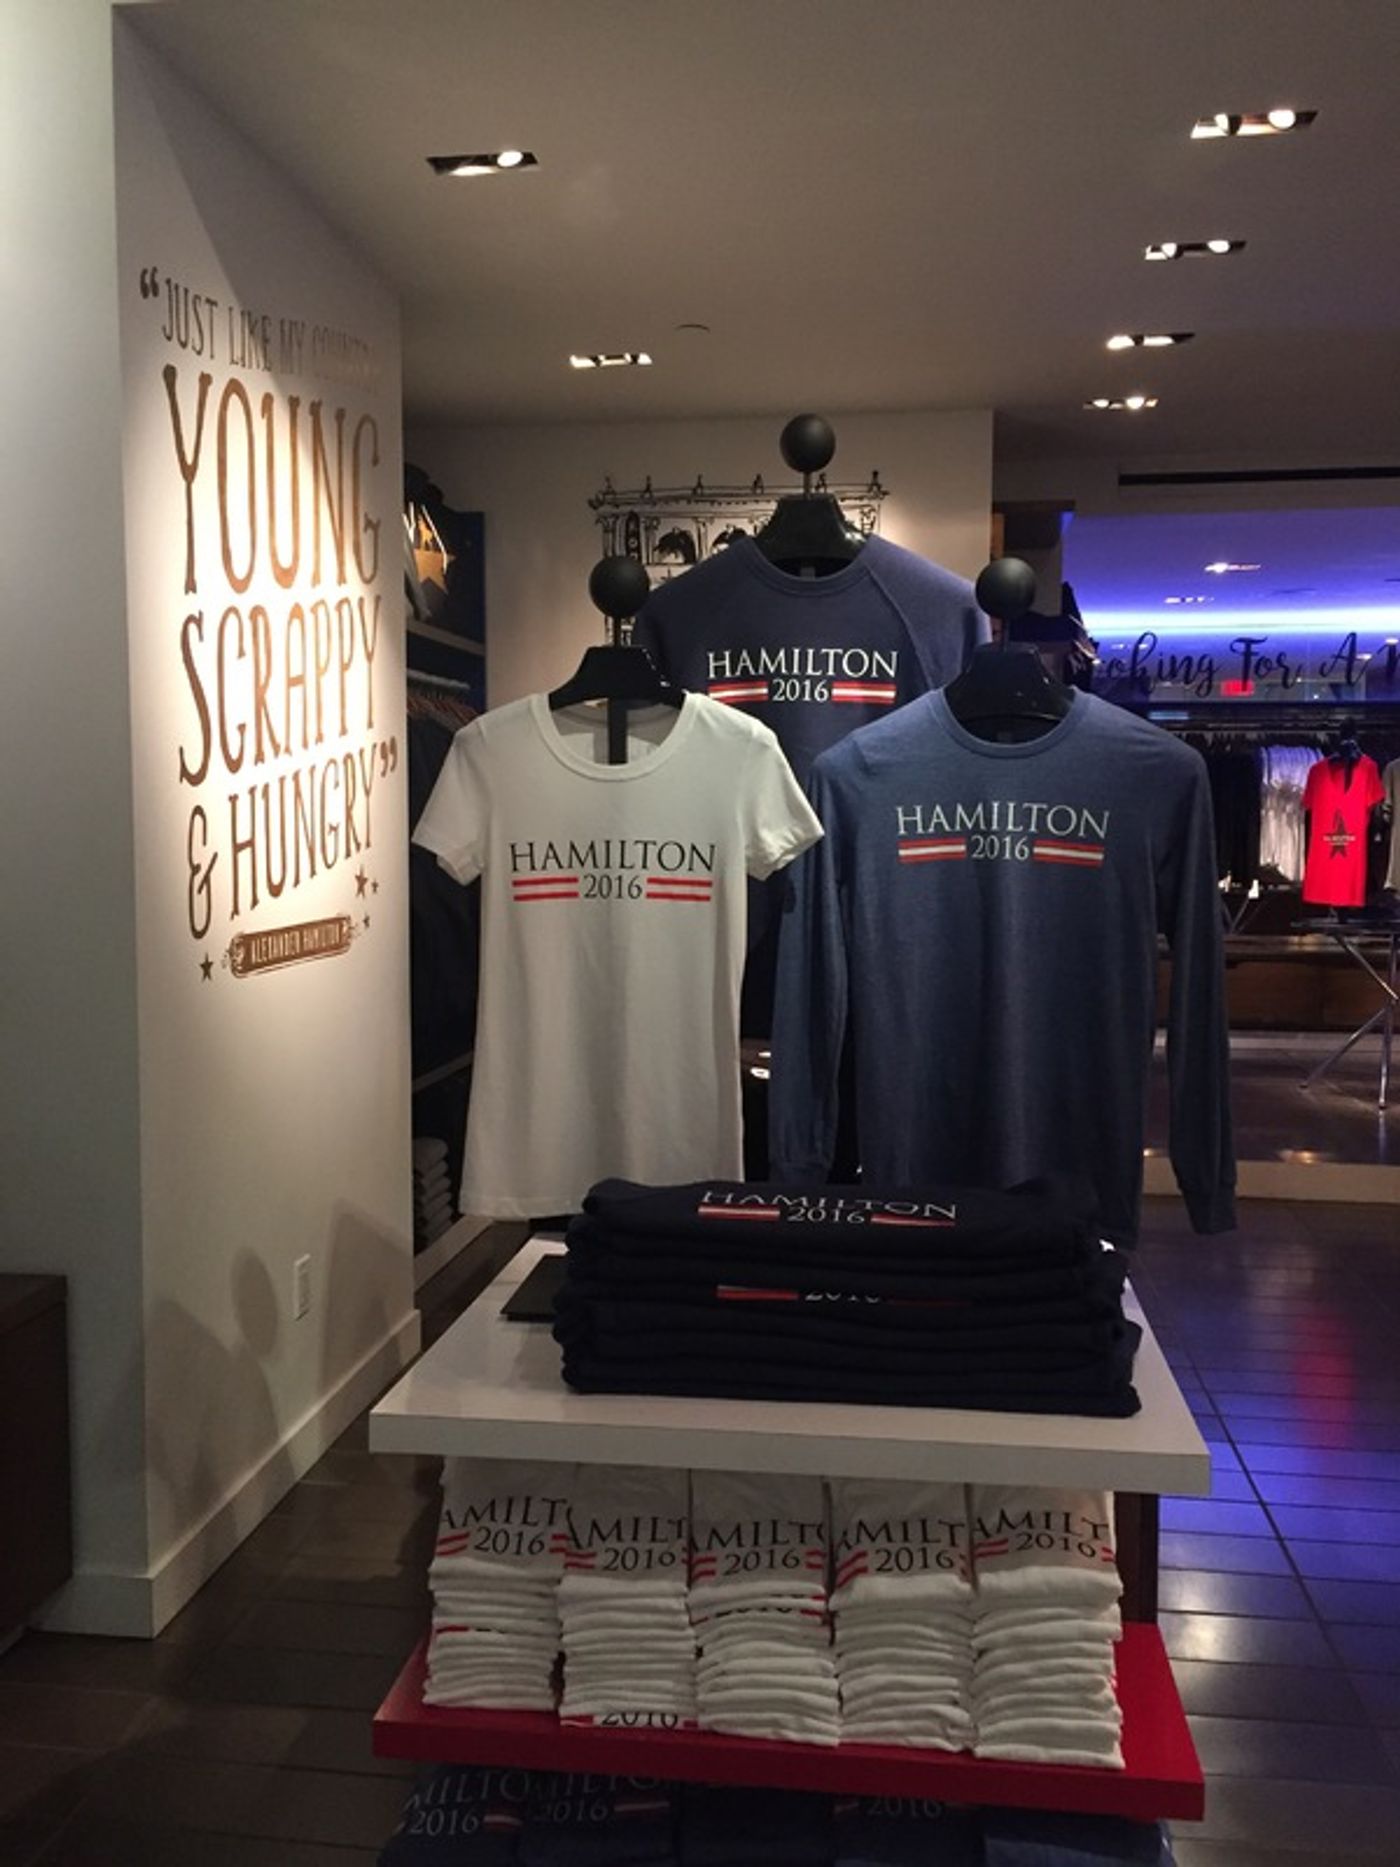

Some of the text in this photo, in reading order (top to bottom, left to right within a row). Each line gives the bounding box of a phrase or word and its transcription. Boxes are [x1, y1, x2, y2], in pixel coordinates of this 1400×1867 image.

[228, 305, 272, 372] LIKE
[280, 317, 305, 375] MY
[162, 363, 381, 595] YOUNG
[708, 648, 898, 678] HAMILTON
[1229, 636, 1302, 694] For
[1319, 632, 1370, 687] A
[179, 594, 381, 787] SCRAPPY
[772, 678, 830, 702] 2016
[897, 801, 1110, 839] HAMILTON
[510, 840, 716, 873] HAMILTON
[971, 835, 1029, 861] 2016
[188, 805, 218, 939] &
[583, 874, 643, 900] 2016
[788, 1206, 865, 1223] 2016
[474, 1526, 545, 1555] 2016
[723, 1549, 800, 1576] 2016
[875, 1546, 954, 1572] 2016
[409, 1807, 480, 1836] 2016
